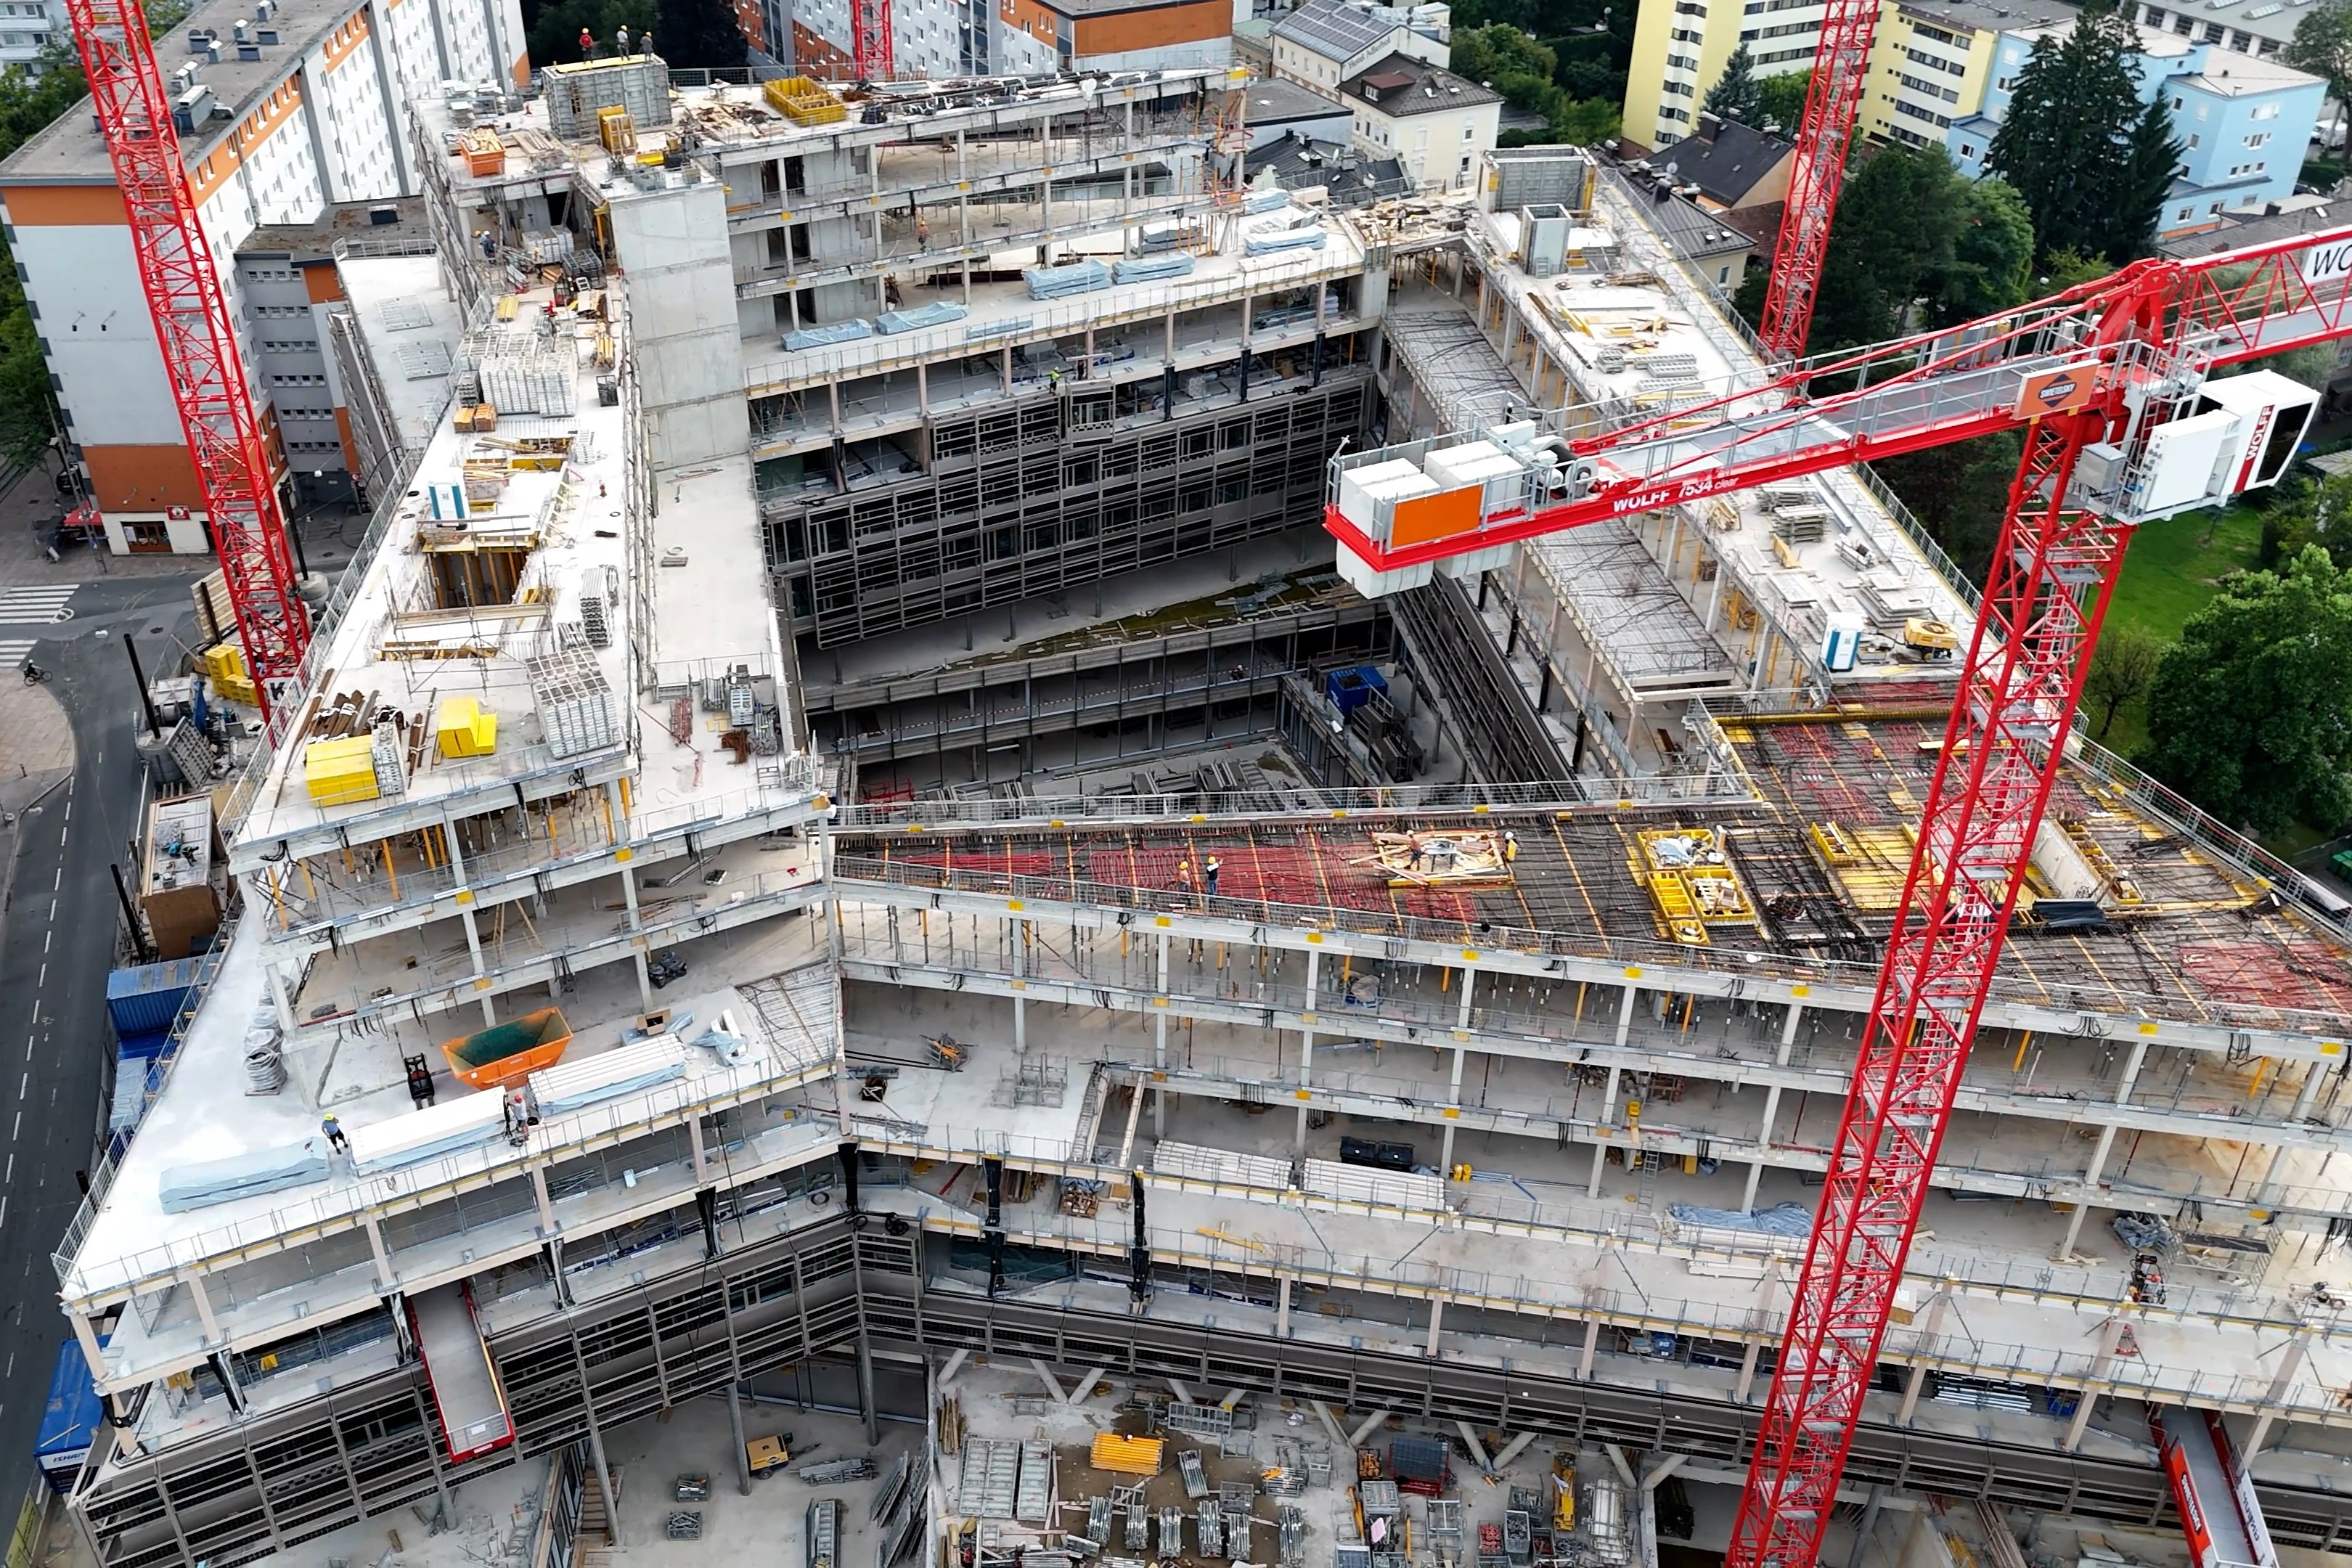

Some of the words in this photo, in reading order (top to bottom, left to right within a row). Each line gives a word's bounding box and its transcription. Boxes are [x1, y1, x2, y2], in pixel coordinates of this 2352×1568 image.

[1348, 53, 1365, 70] Hotel
[1366, 36, 1391, 58] Adlerhof
[2245, 406, 2271, 462] WOLFF
[1614, 489, 1670, 513] WOLFF
[1678, 477, 1713, 498] 7534
[1714, 477, 1739, 490] clear
